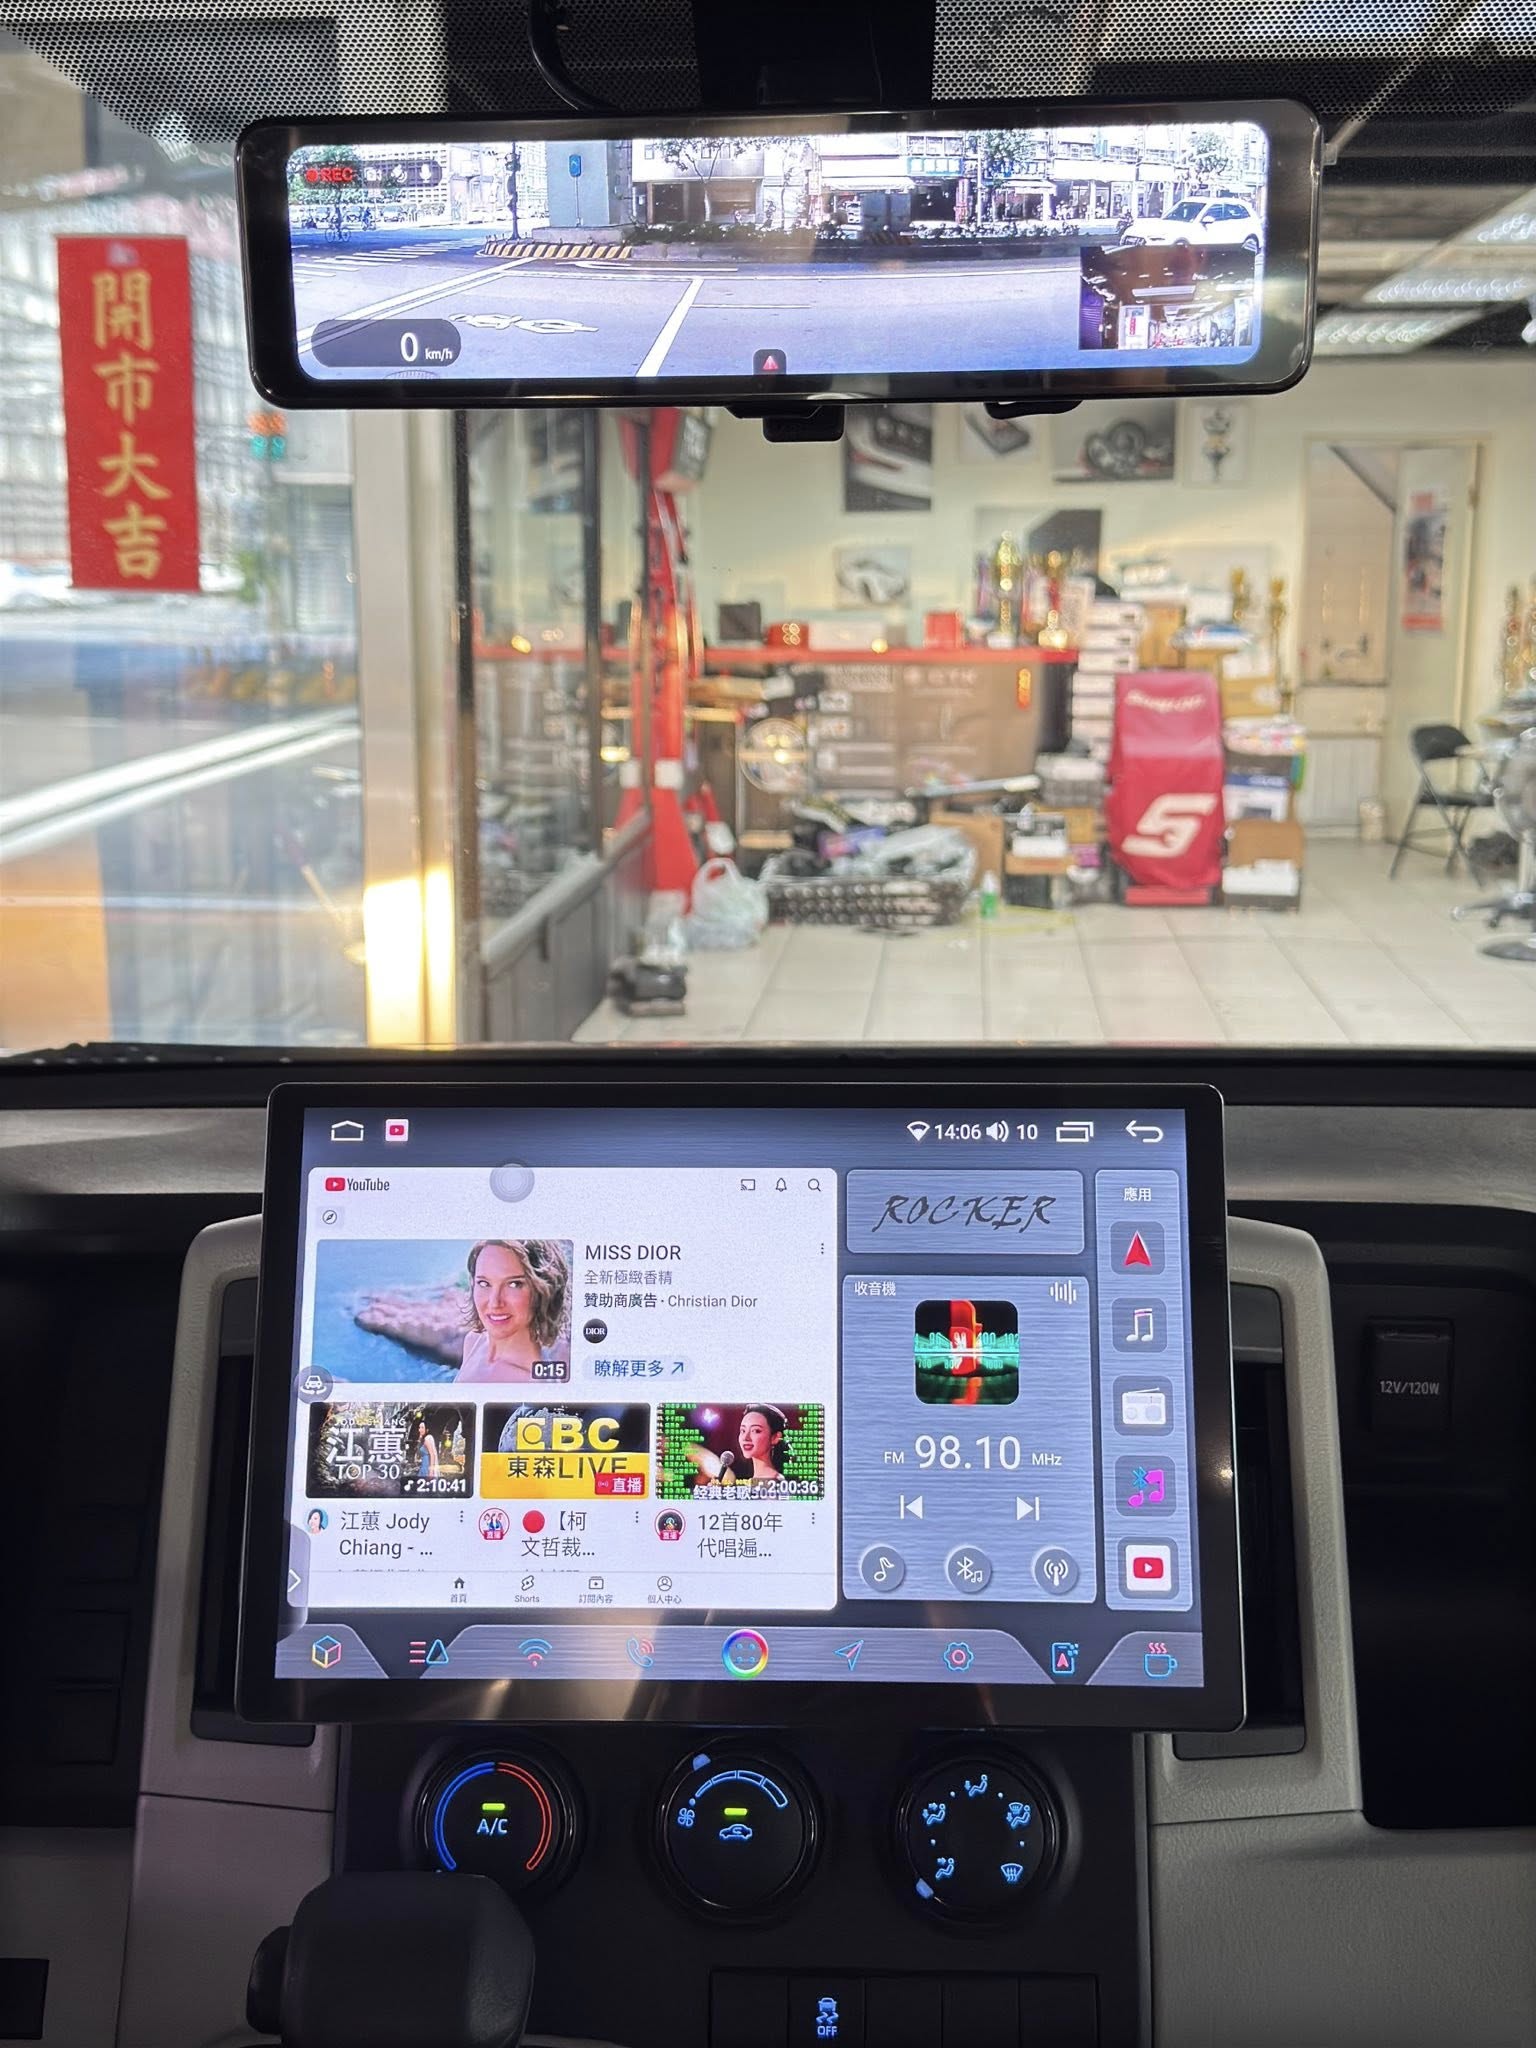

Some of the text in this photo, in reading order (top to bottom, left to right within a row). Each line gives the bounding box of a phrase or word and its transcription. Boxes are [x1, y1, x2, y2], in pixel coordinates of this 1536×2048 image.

[319, 166, 353, 183] REC
[399, 331, 453, 363] 0 km/h
[92, 268, 172, 581] 開市大吉
[934, 1122, 982, 1141] 14:06
[1017, 1123, 1039, 1141] 10
[347, 1177, 391, 1193] YouTube
[1123, 1186, 1152, 1203] 應用
[871, 1194, 1058, 1234] ROCKER
[585, 1244, 682, 1262] MISS DIOR
[854, 1281, 896, 1297] 收音機
[583, 1292, 758, 1309] 贊助商廣告 Christian Dior
[585, 1327, 605, 1335] DIOR
[534, 1361, 565, 1378] 0:15
[594, 1360, 664, 1377] 瞭解更多
[1380, 1381, 1440, 1395] 12V/120W
[884, 1435, 1062, 1470] FM 98.10 MHz
[334, 1464, 400, 1480] TOP 30
[417, 1479, 466, 1492] 2:10:41
[612, 1478, 642, 1493] 直播
[767, 1481, 819, 1494] 2:00:36
[386, 1513, 430, 1533] Jody
[698, 1512, 784, 1533] 12首80年
[339, 1539, 402, 1559] Chiang
[514, 1594, 540, 1603] Shorts
[647, 1594, 682, 1605] 個人中心
[476, 1818, 508, 1836] A/C
[816, 2025, 837, 2037] OFF
